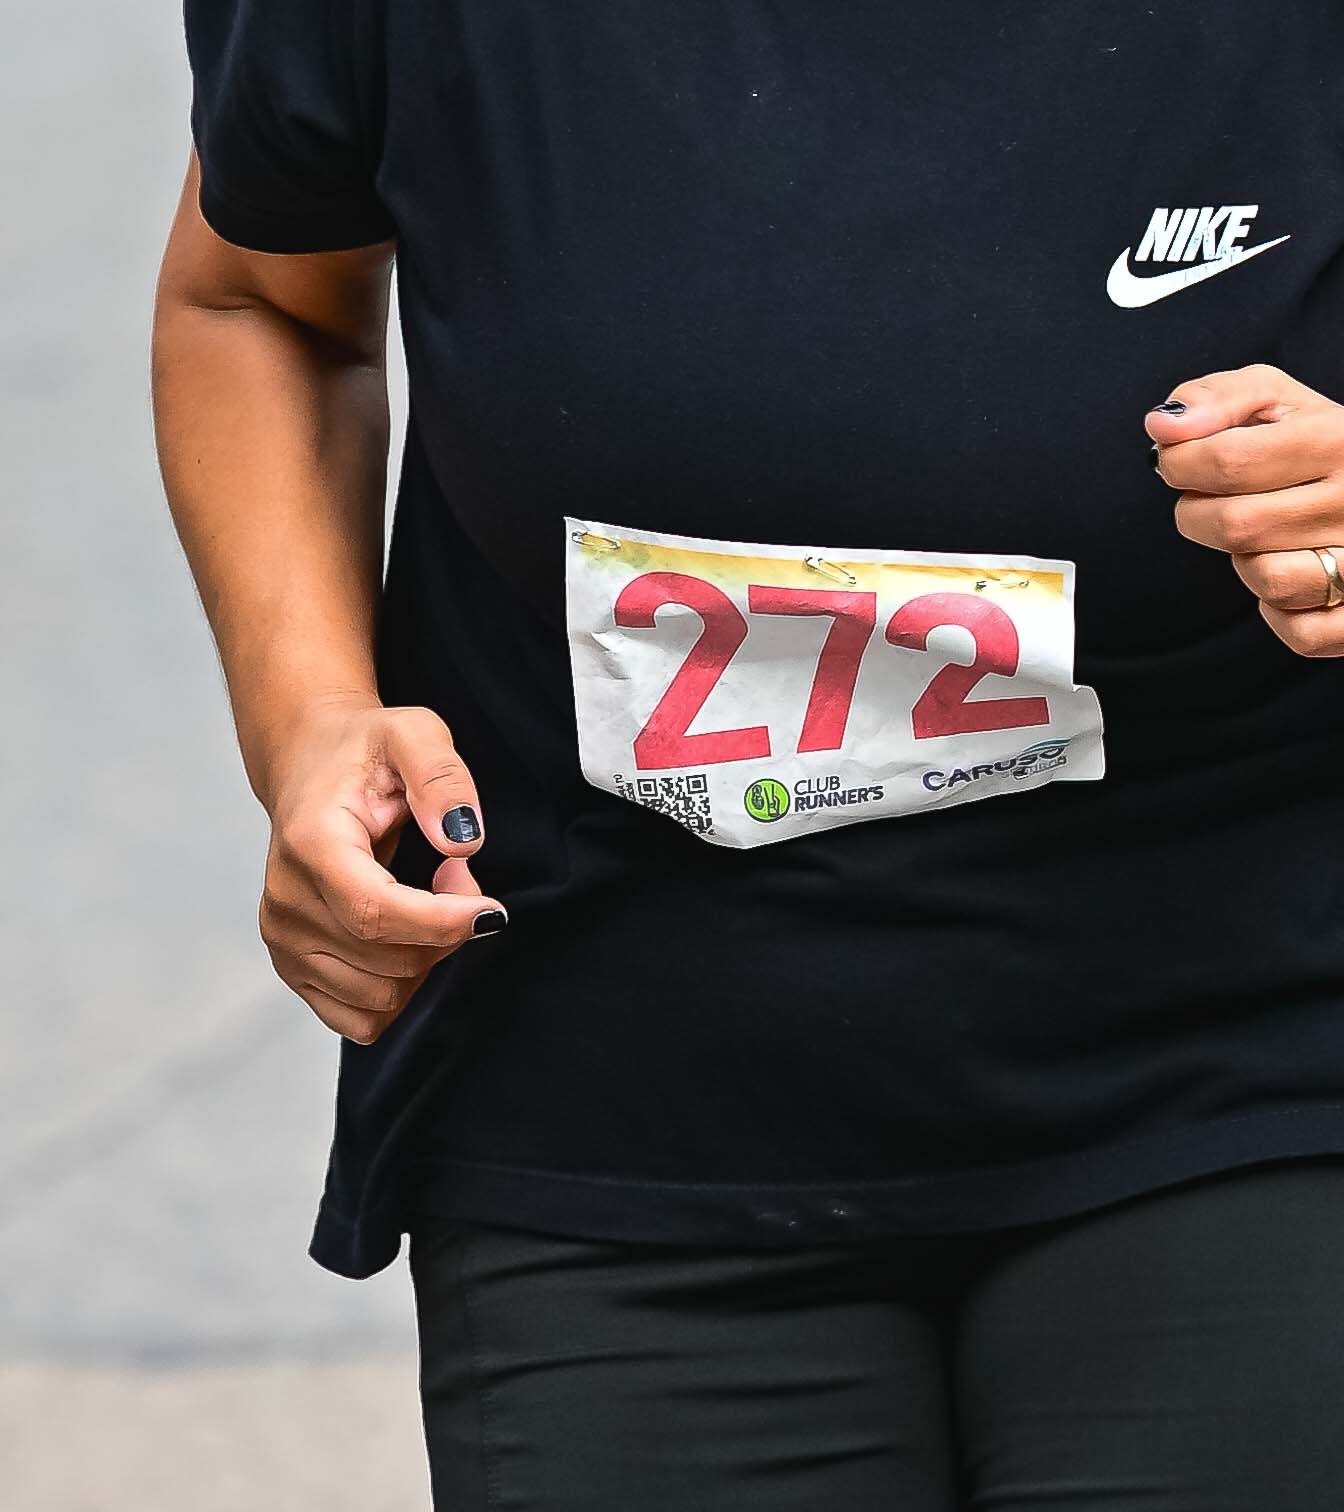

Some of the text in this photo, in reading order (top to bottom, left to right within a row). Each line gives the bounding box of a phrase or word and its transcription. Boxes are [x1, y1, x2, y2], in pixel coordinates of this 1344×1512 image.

[1134, 204, 1259, 263] NIKE
[613, 571, 1050, 770] 272
[794, 775, 841, 796] CLUB
[922, 746, 1065, 791] CARUSO
[794, 785, 884, 813] RUNNER'S
